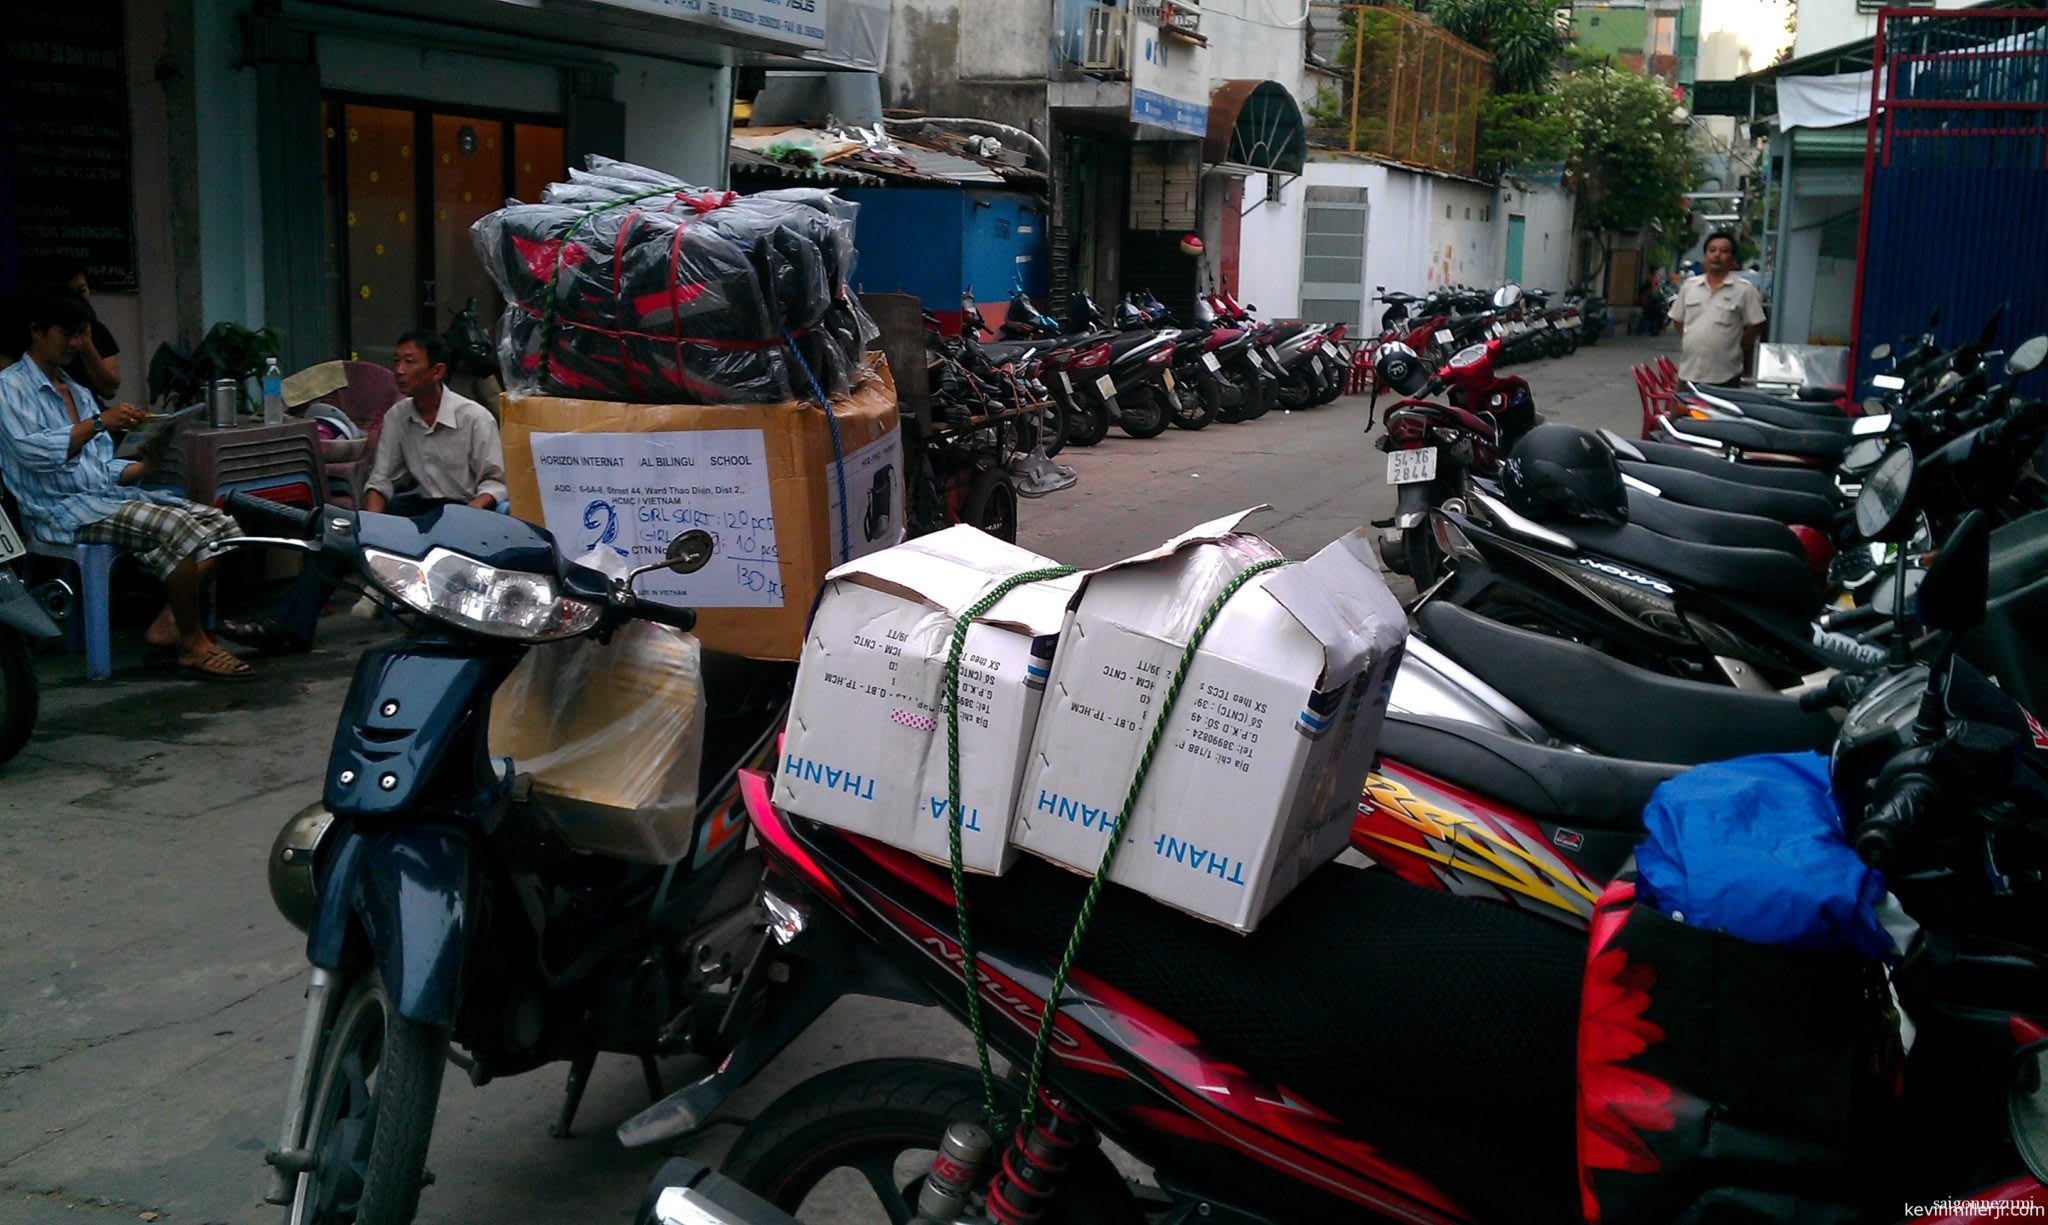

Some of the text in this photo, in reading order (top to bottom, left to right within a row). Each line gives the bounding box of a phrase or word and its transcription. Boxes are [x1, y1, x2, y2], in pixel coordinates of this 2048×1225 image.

[539, 455, 580, 466] HORIZON
[710, 455, 752, 466] SCHOOL
[1394, 450, 1429, 467] 54-X6
[1394, 465, 1428, 482] 2844
[606, 486, 629, 495] Street
[645, 486, 667, 495] Ward
[669, 486, 690, 495] Thao
[715, 485, 732, 494] Dist
[611, 497, 636, 506] HCMC
[642, 497, 681, 506] VIETNAM
[631, 546, 652, 554] CTN
[736, 534, 755, 553] 10
[853, 635, 876, 650] CNTC
[970, 655, 987, 667] theo
[988, 659, 1001, 671] SX
[1103, 665, 1127, 681] CNTC
[824, 673, 857, 690] TP.HCM
[865, 685, 887, 698] Q.BT
[1206, 685, 1230, 702] TCCS
[976, 702, 990, 715] Tel:
[1070, 701, 1105, 722] TP.HCM
[1217, 704, 1249, 724] (CNTC)
[1254, 701, 1268, 714] SX
[1113, 717, 1136, 731] Q.BT
[1248, 716, 1263, 729] Số
[1192, 729, 1235, 751] 38990824
[1222, 723, 1259, 744] G.P.K.D
[1188, 743, 1212, 760] 1/18B
[1237, 745, 1254, 758] Tel:
[1235, 760, 1250, 773] Địa
[785, 754, 876, 800] THANH
